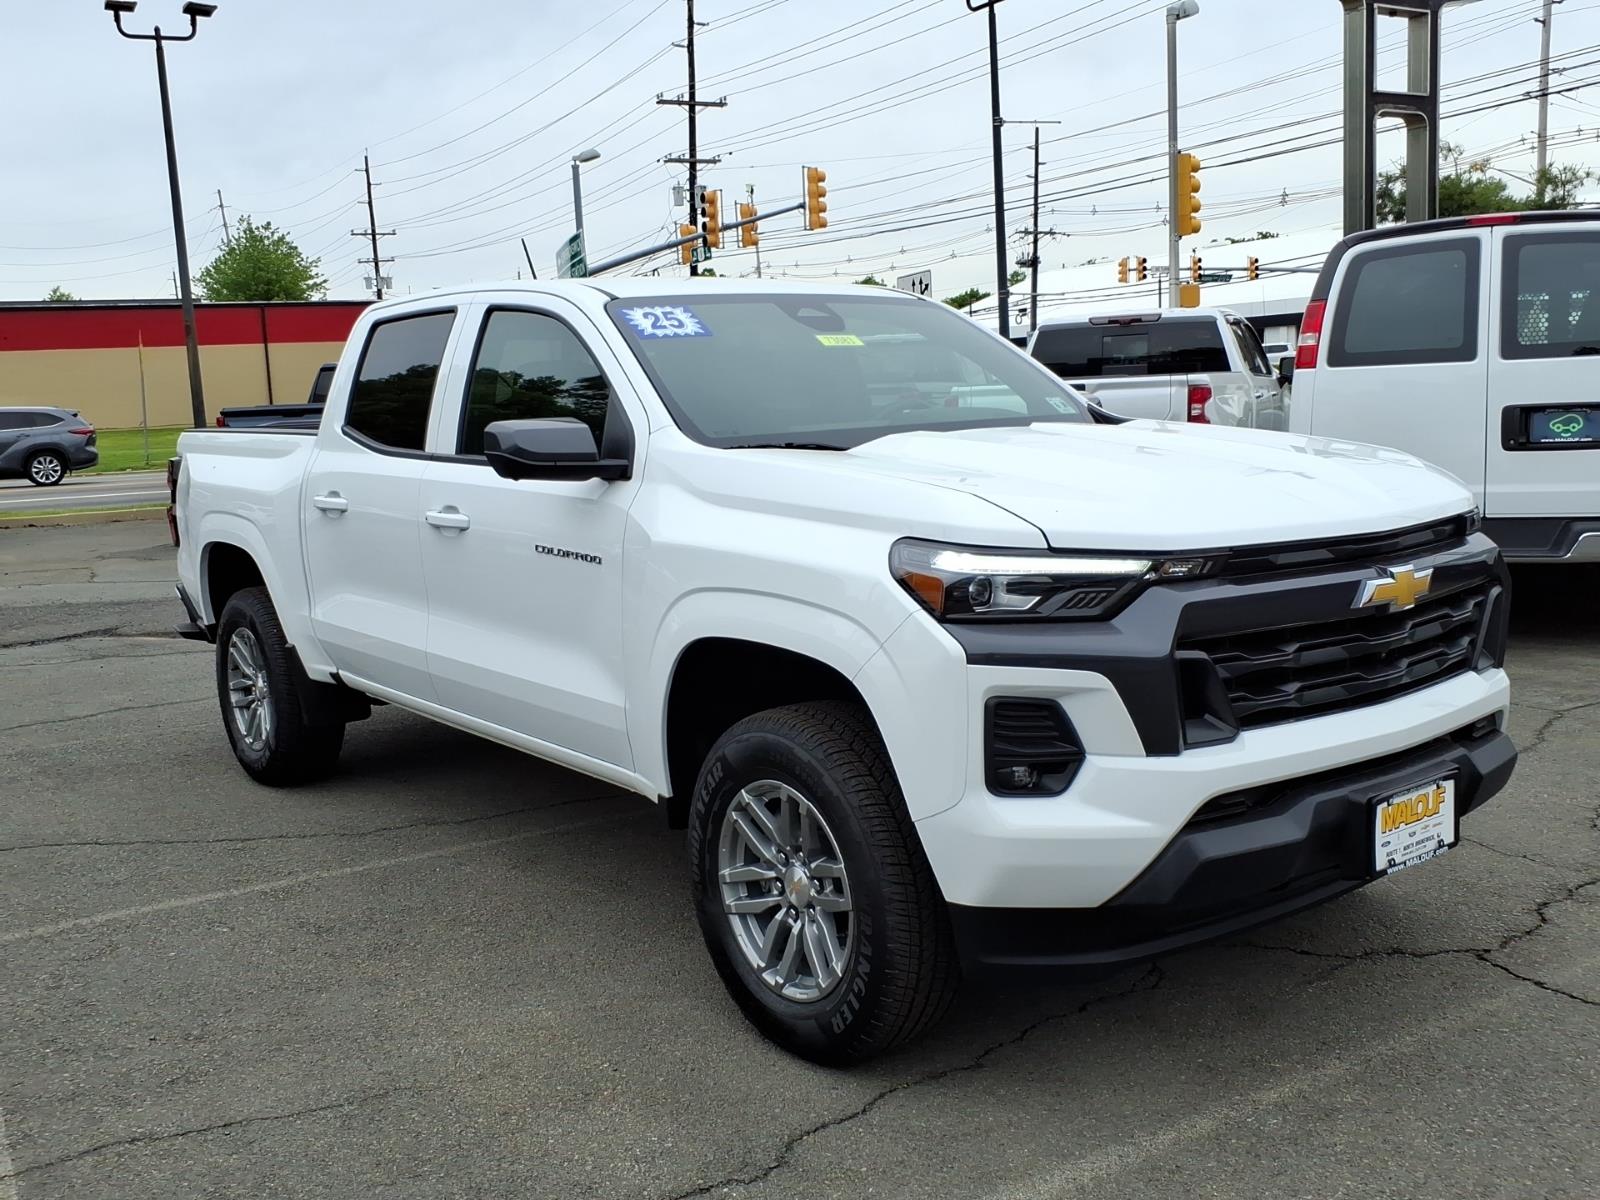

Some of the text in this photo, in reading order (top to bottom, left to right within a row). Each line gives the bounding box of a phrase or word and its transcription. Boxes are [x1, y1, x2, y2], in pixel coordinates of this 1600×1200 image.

[641, 311, 686, 330] 25
[535, 544, 602, 565] COLORADO
[1381, 786, 1446, 834] MALOUF
[1387, 846, 1449, 875] www.MALOUF.com
